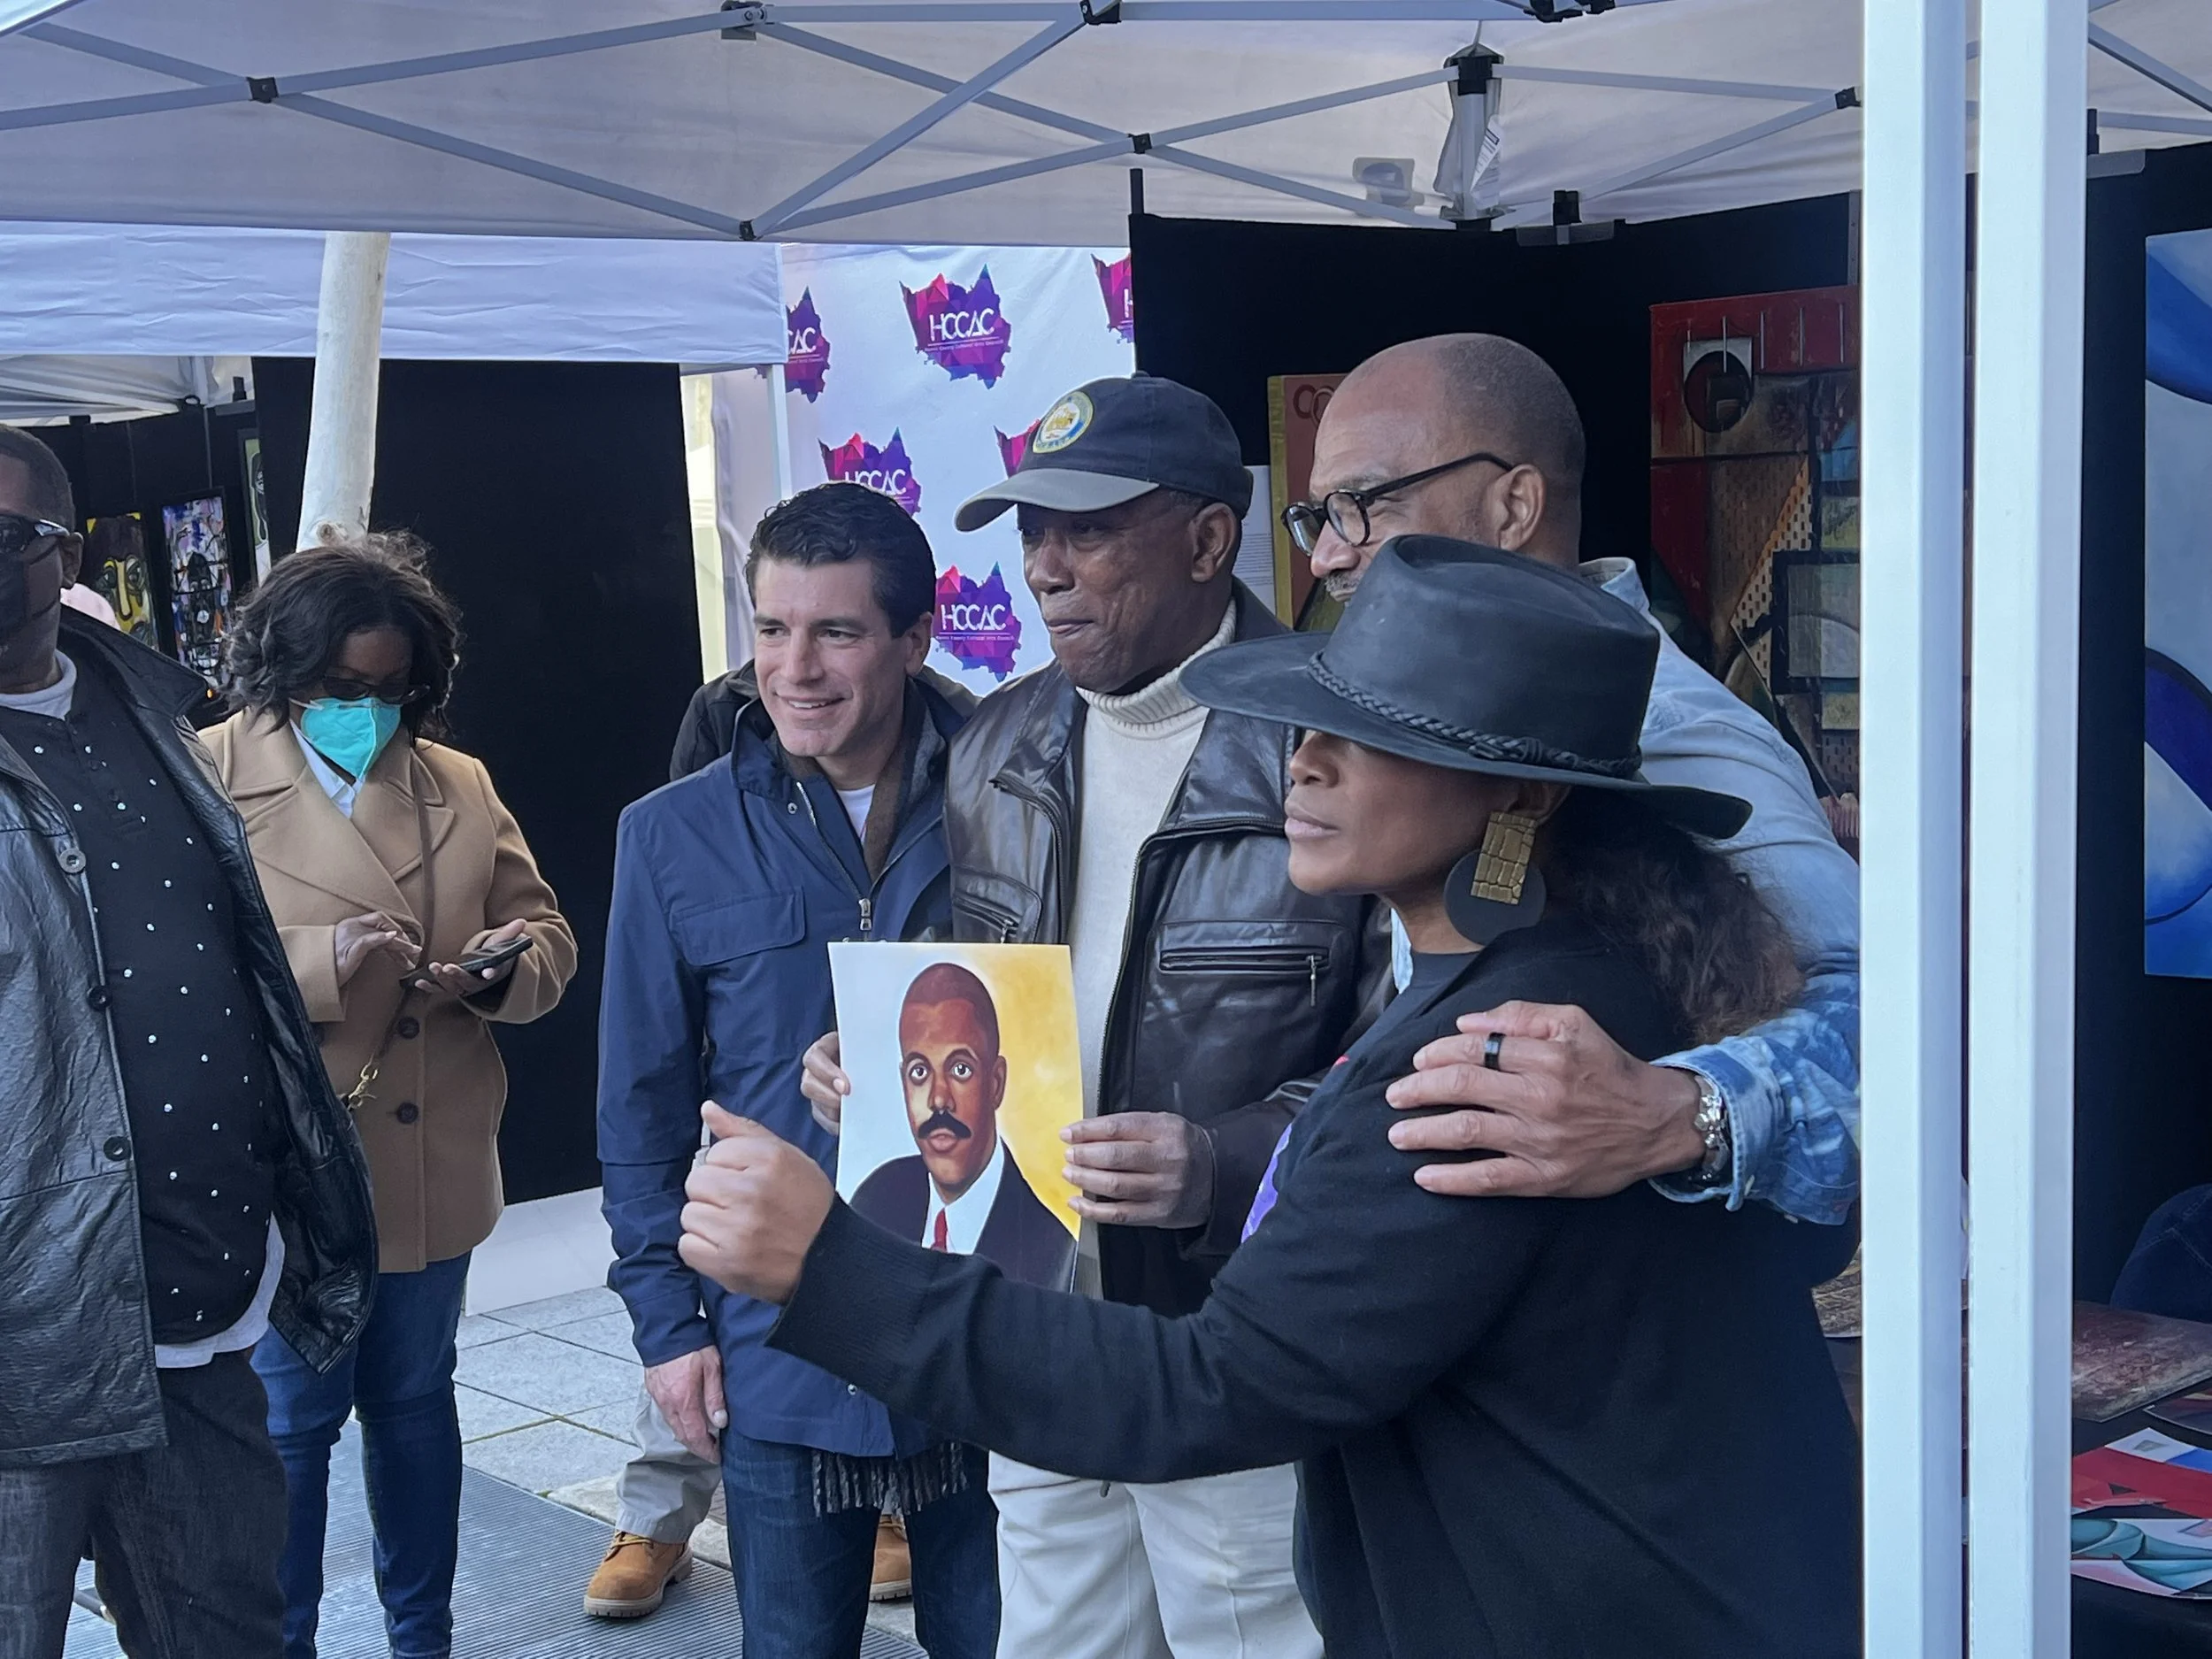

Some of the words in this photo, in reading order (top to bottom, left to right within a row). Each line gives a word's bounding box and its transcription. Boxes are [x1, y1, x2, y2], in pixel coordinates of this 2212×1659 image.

[929, 308, 995, 342] HCCAC
[787, 326, 817, 354] AC
[941, 603, 1007, 631] HCCAC
